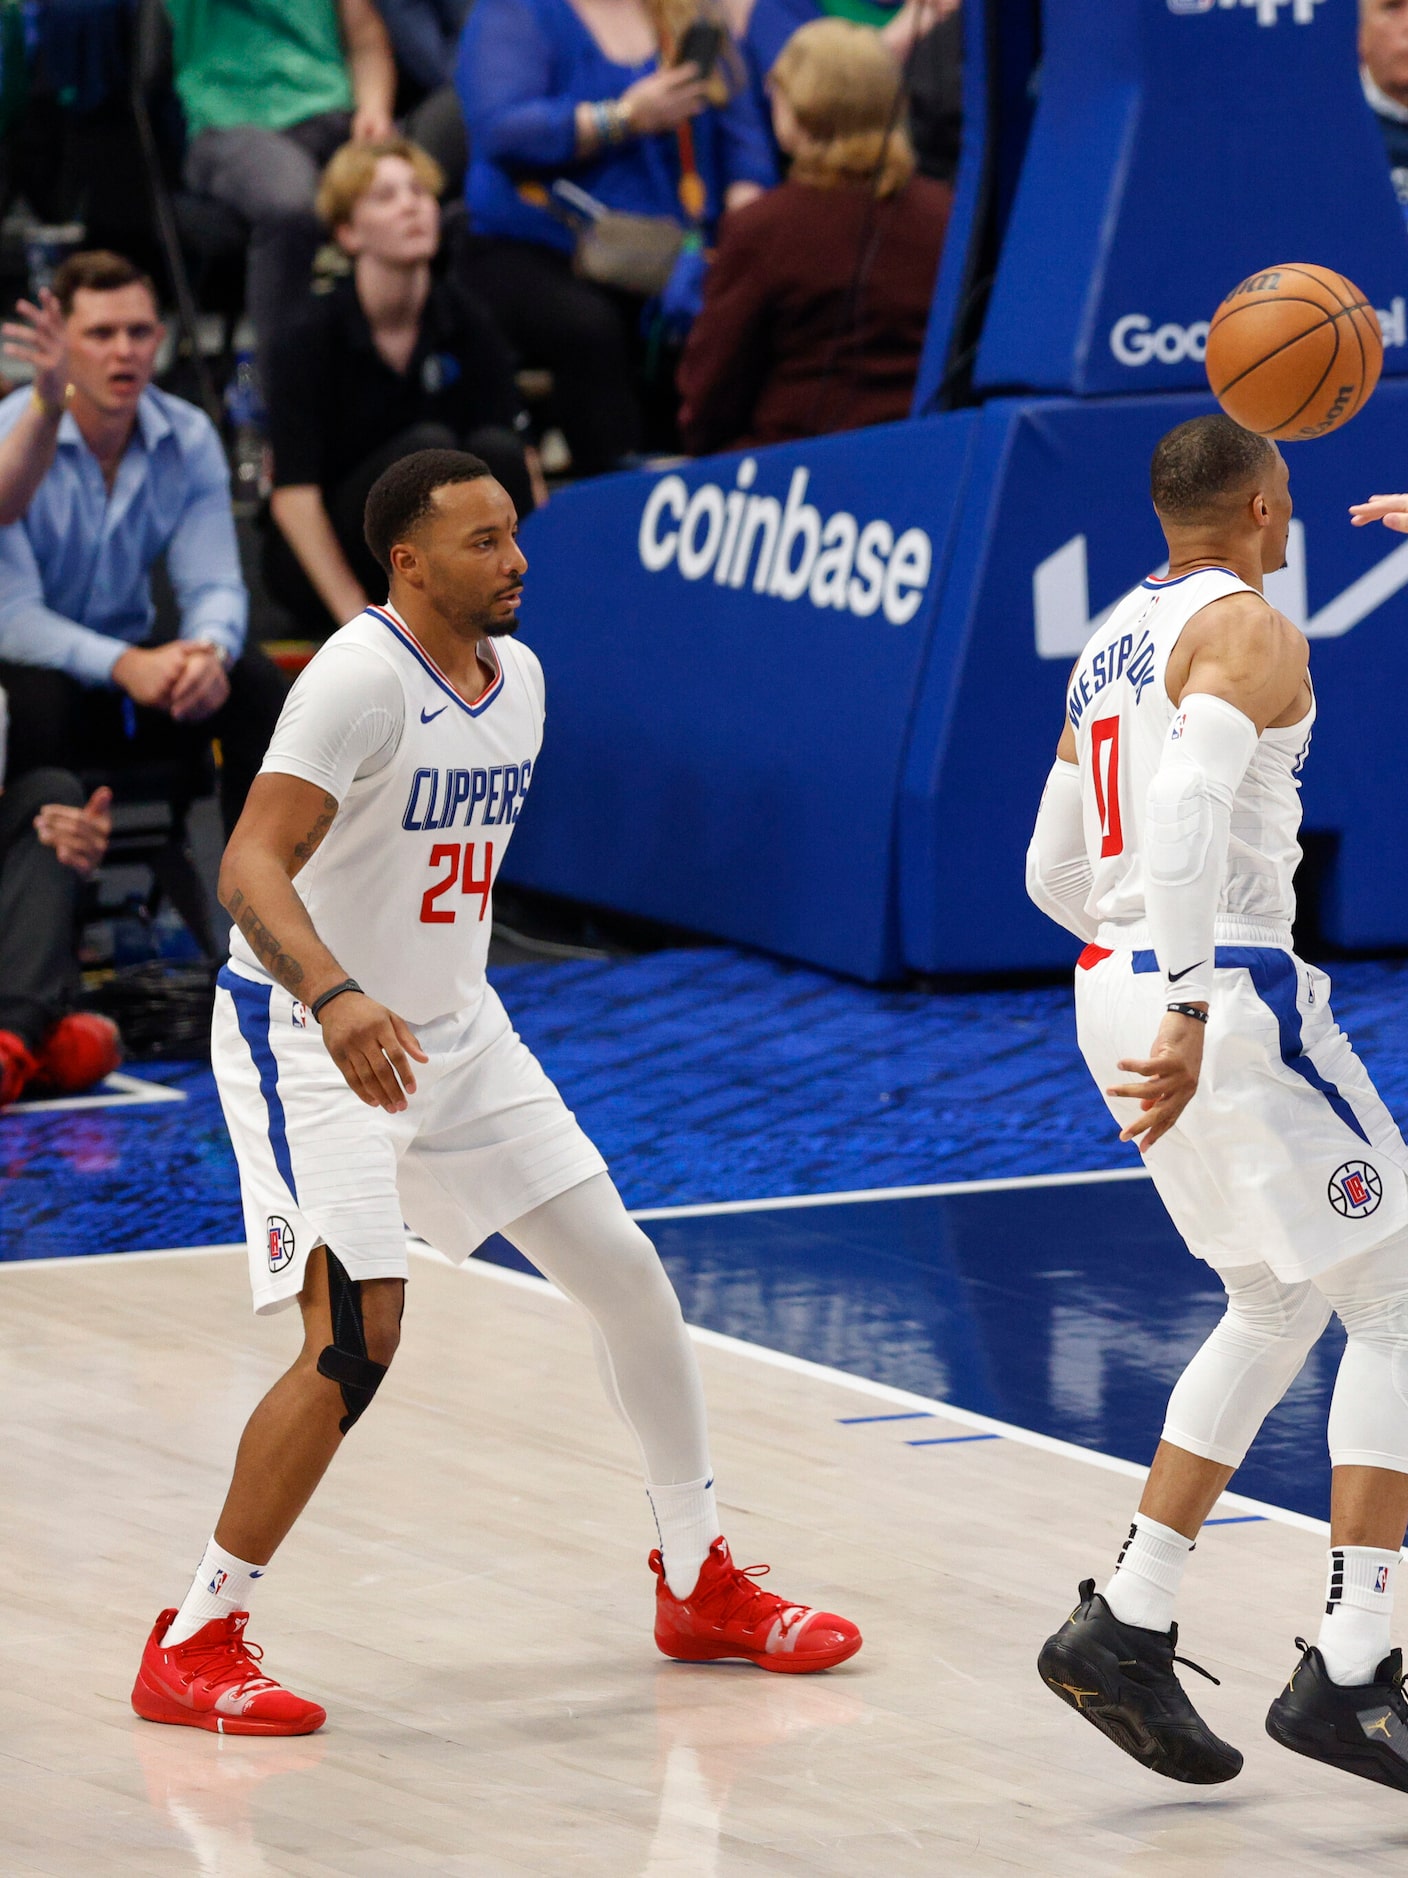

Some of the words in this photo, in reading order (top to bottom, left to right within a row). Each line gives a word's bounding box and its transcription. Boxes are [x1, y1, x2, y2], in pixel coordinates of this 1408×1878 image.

[1109, 313, 1211, 367] Goo
[638, 457, 932, 625] coinbase
[402, 758, 533, 831] CLIPPERS
[1090, 715, 1124, 859] 0
[419, 841, 493, 924] 24
